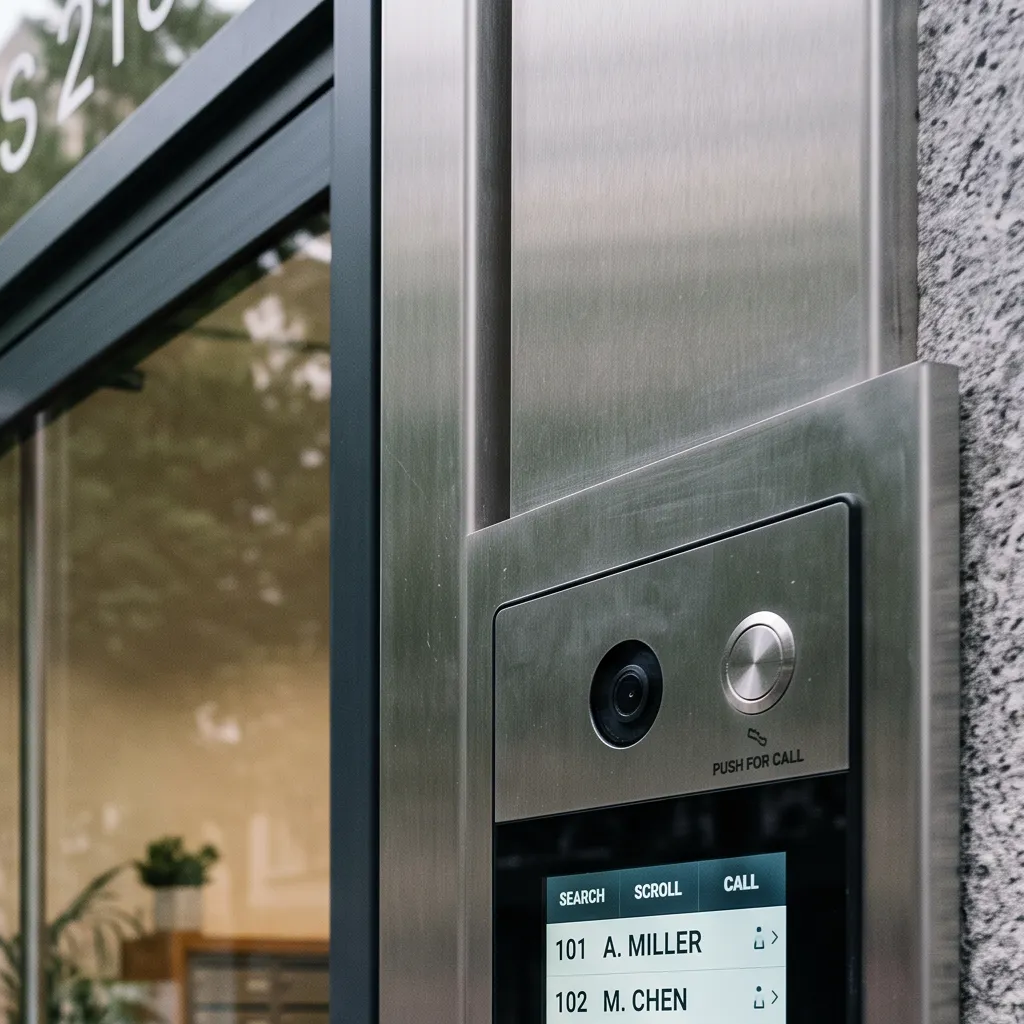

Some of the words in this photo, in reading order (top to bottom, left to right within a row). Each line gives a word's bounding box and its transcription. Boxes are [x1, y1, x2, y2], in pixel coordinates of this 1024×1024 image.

[56, 0, 175, 125] 21
[713, 761, 743, 776] PUSH
[746, 755, 769, 770] FOR
[773, 749, 804, 766] CALL
[635, 881, 682, 899] SCROLL
[724, 874, 759, 891] CALL
[560, 888, 604, 906] SEARCH
[556, 938, 584, 960] 101
[603, 936, 621, 958] A.
[629, 930, 701, 956] MILLER
[556, 991, 587, 1012] 102
[604, 990, 625, 1012] M.
[633, 988, 686, 1011] CHEN
